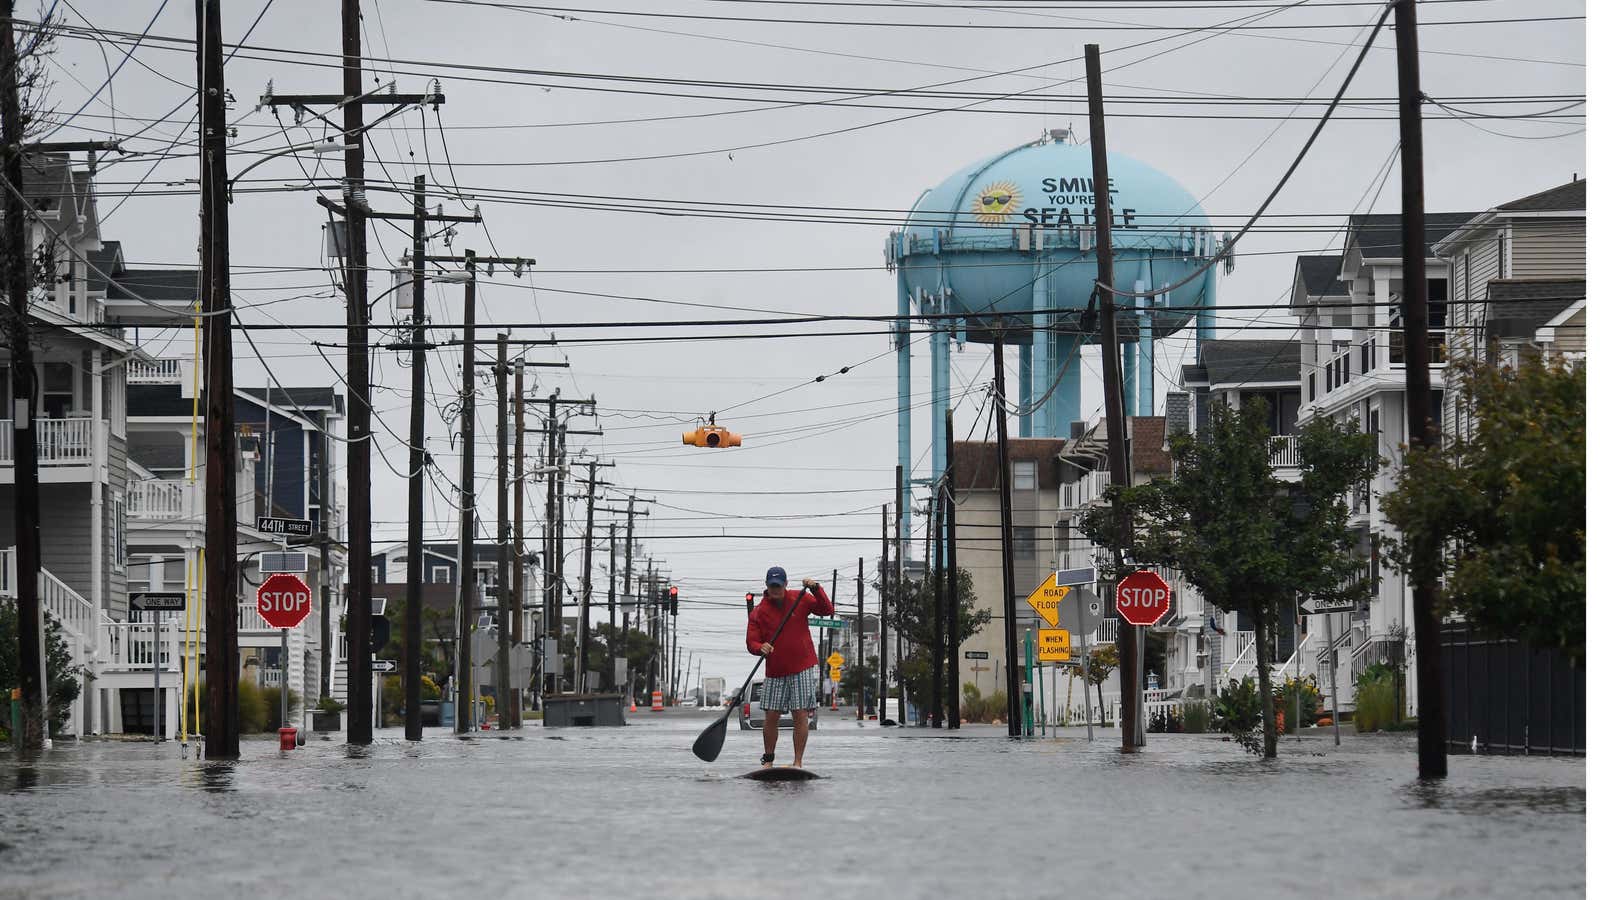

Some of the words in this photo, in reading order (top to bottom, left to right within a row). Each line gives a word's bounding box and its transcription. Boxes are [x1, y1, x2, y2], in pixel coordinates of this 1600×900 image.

[1048, 194, 1096, 205] YOU'RE
[1023, 207, 1074, 229] SEA
[261, 519, 285, 532] 44TH
[288, 523, 308, 532] STREET
[1043, 589, 1064, 598] ROAD
[1120, 587, 1166, 608] STOP
[145, 598, 161, 606] ONE
[163, 598, 180, 606] WAY
[261, 591, 308, 612] STOP
[1036, 601, 1058, 610] FLOO
[1045, 635, 1063, 643] WHEN
[1039, 646, 1069, 654] FLASHING
